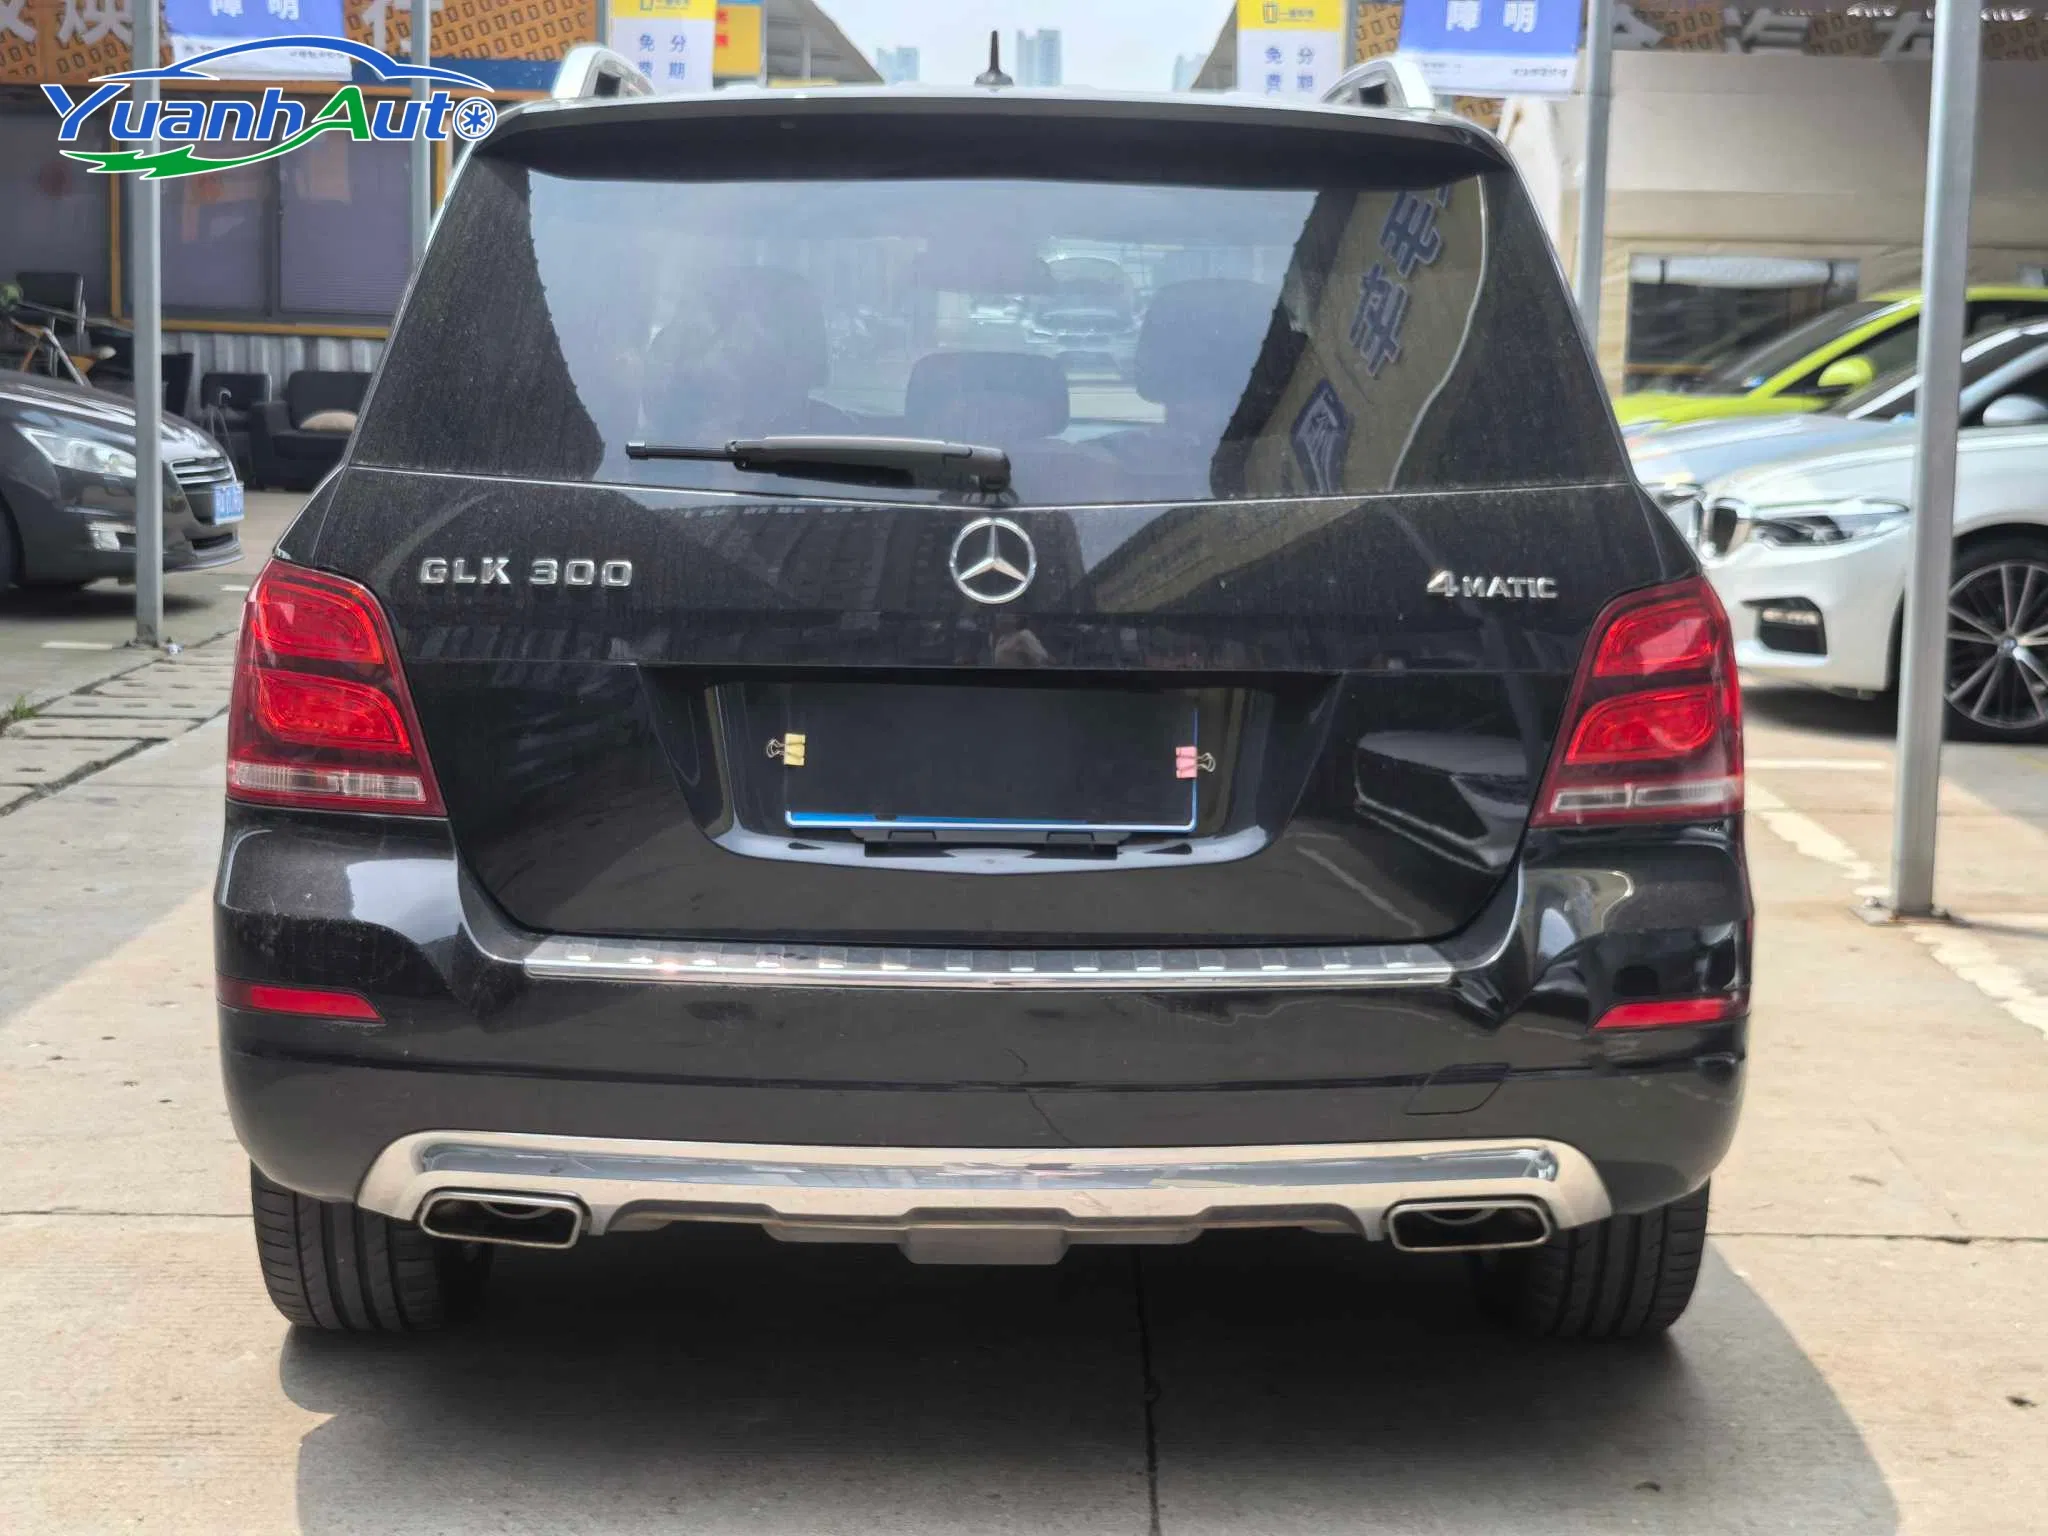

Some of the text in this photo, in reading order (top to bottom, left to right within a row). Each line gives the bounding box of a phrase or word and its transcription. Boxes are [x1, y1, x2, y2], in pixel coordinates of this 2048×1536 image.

[420, 557, 633, 587] GLK 300
[1426, 570, 1559, 599] 4MATIC
